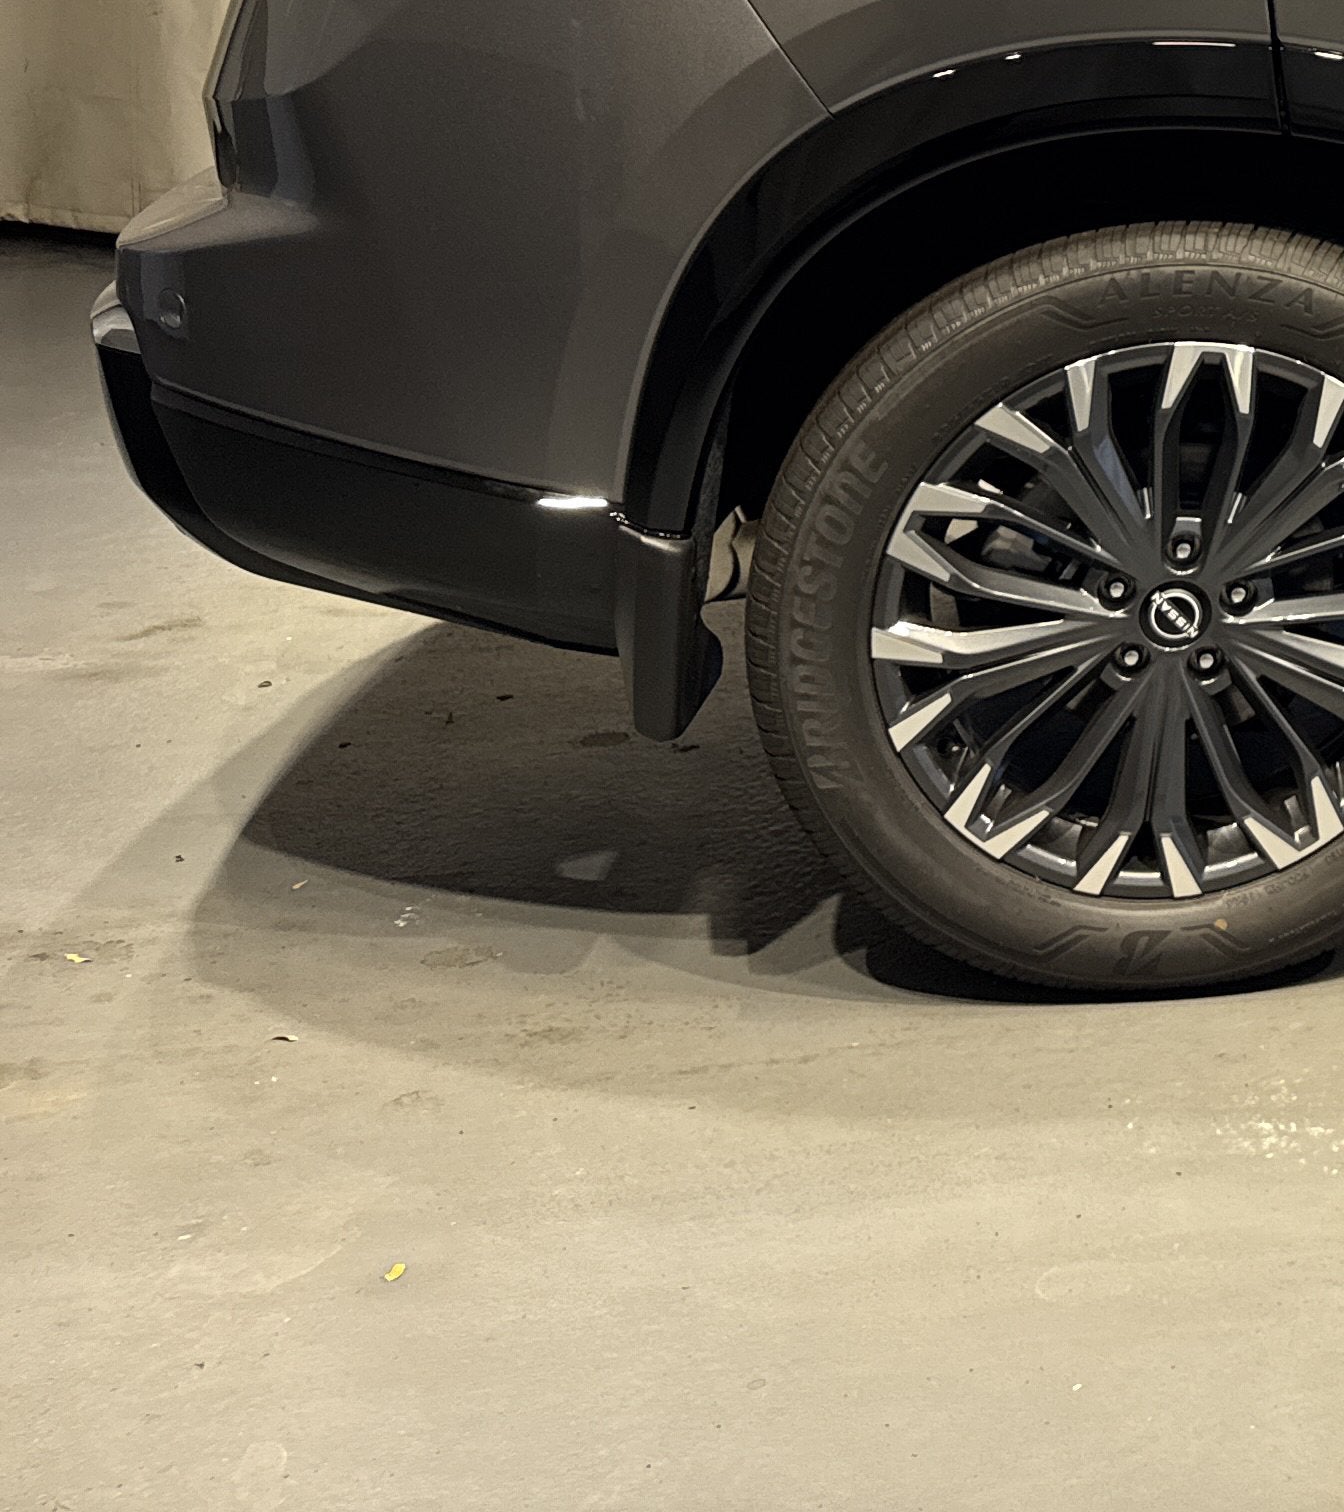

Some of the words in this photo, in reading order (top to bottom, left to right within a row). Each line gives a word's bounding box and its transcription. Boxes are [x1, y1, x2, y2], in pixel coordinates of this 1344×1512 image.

[1098, 269, 1315, 316] ALENZA
[790, 439, 889, 790] BRIDGESTONE
[1150, 590, 1199, 638] NISSAN
